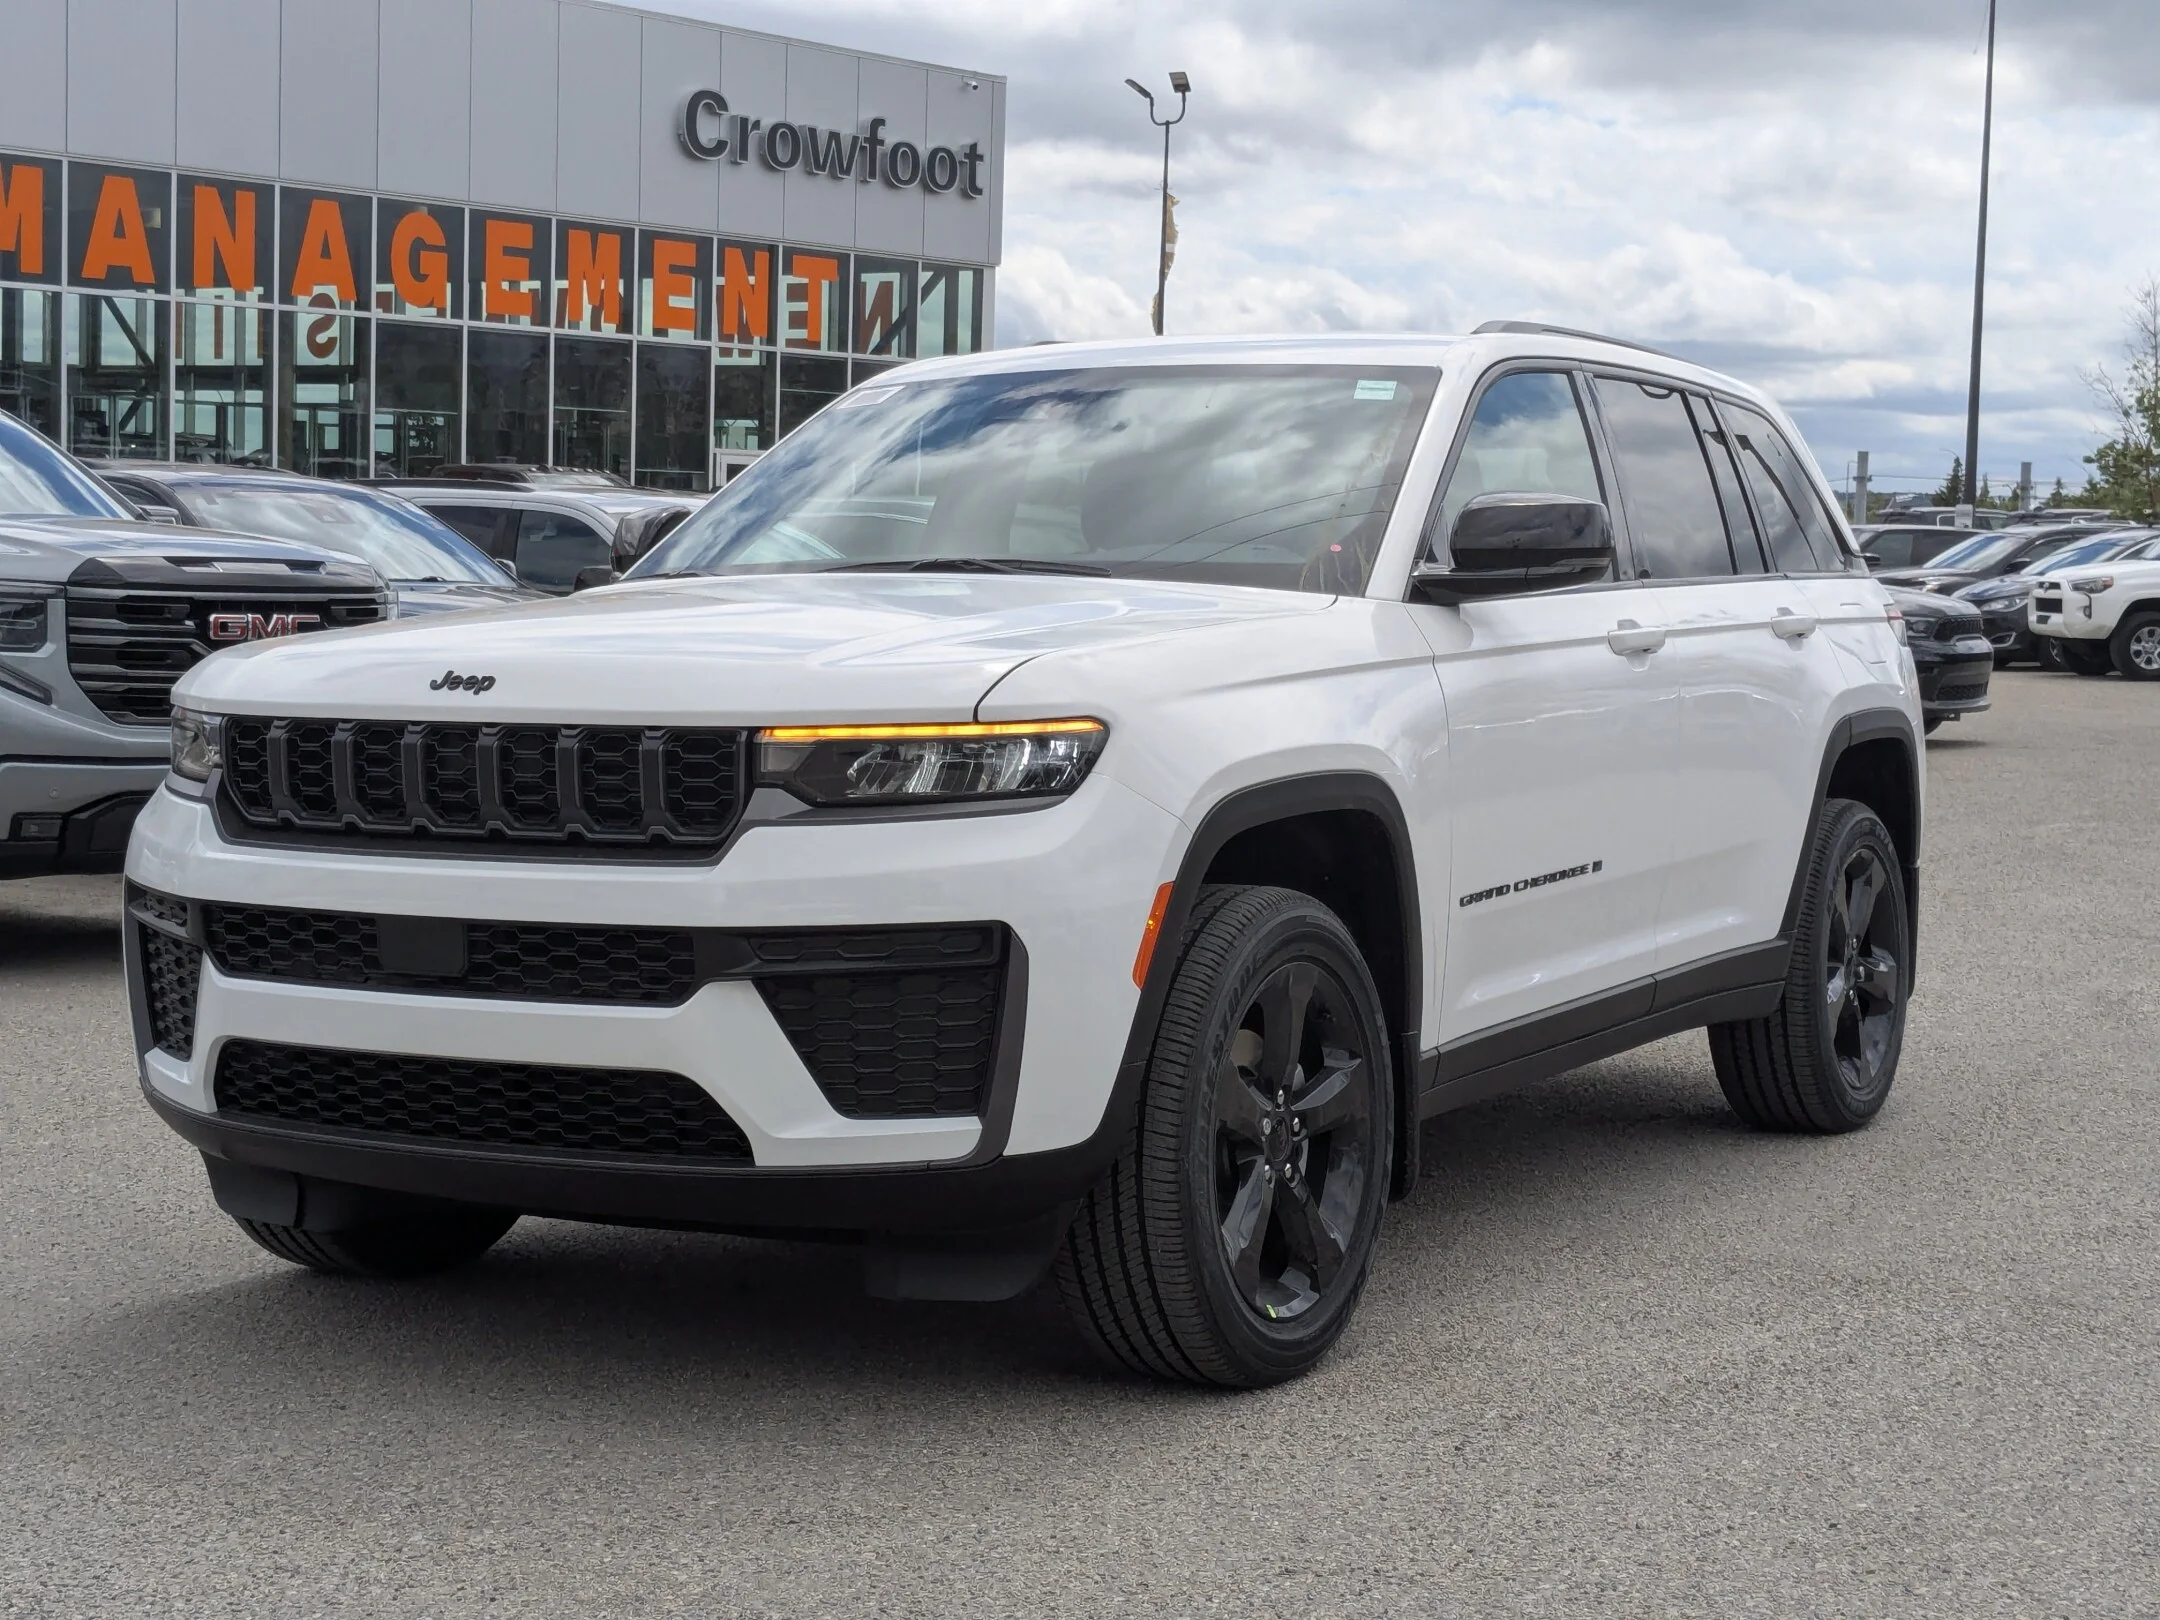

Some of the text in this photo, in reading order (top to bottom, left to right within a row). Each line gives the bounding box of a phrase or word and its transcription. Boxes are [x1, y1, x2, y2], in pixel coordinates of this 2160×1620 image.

[682, 89, 984, 198] Crowfoot
[0, 162, 838, 343] MANAGEMENT
[429, 670, 497, 696] Jeep
[1459, 863, 1591, 908] GRAND CHEROKEE
